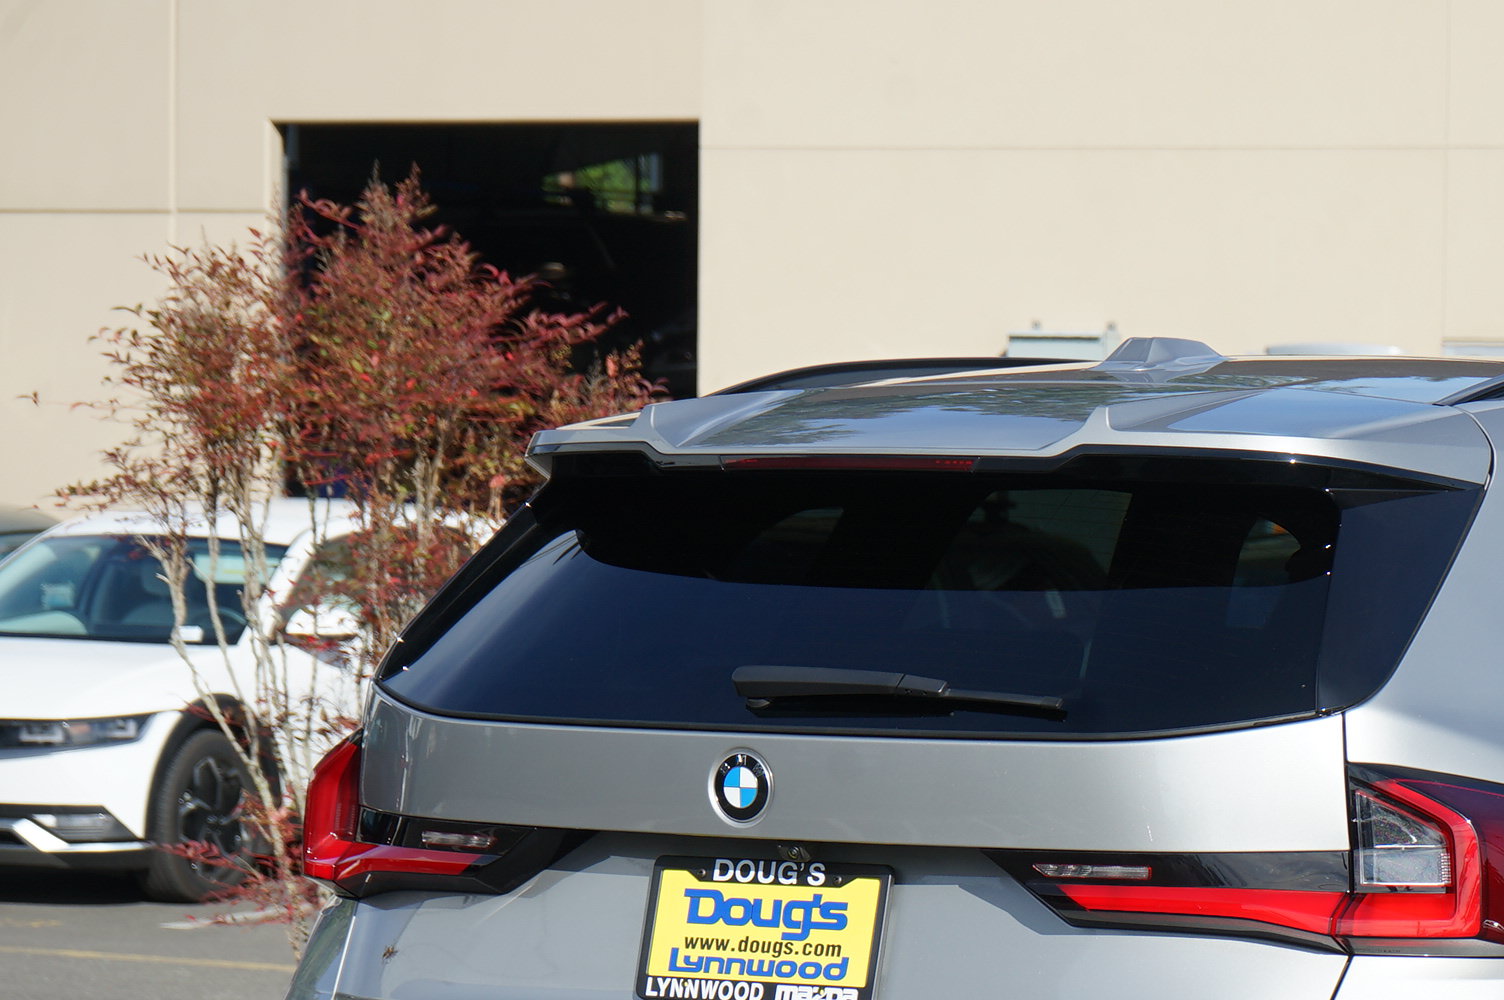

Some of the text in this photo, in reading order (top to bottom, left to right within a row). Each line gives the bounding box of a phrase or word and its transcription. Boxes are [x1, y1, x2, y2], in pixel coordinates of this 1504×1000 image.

[712, 859, 826, 887] DOUG'S
[684, 888, 849, 941] Doug's
[684, 936, 842, 958] www.dougs.com
[668, 947, 850, 981] Lynnwood
